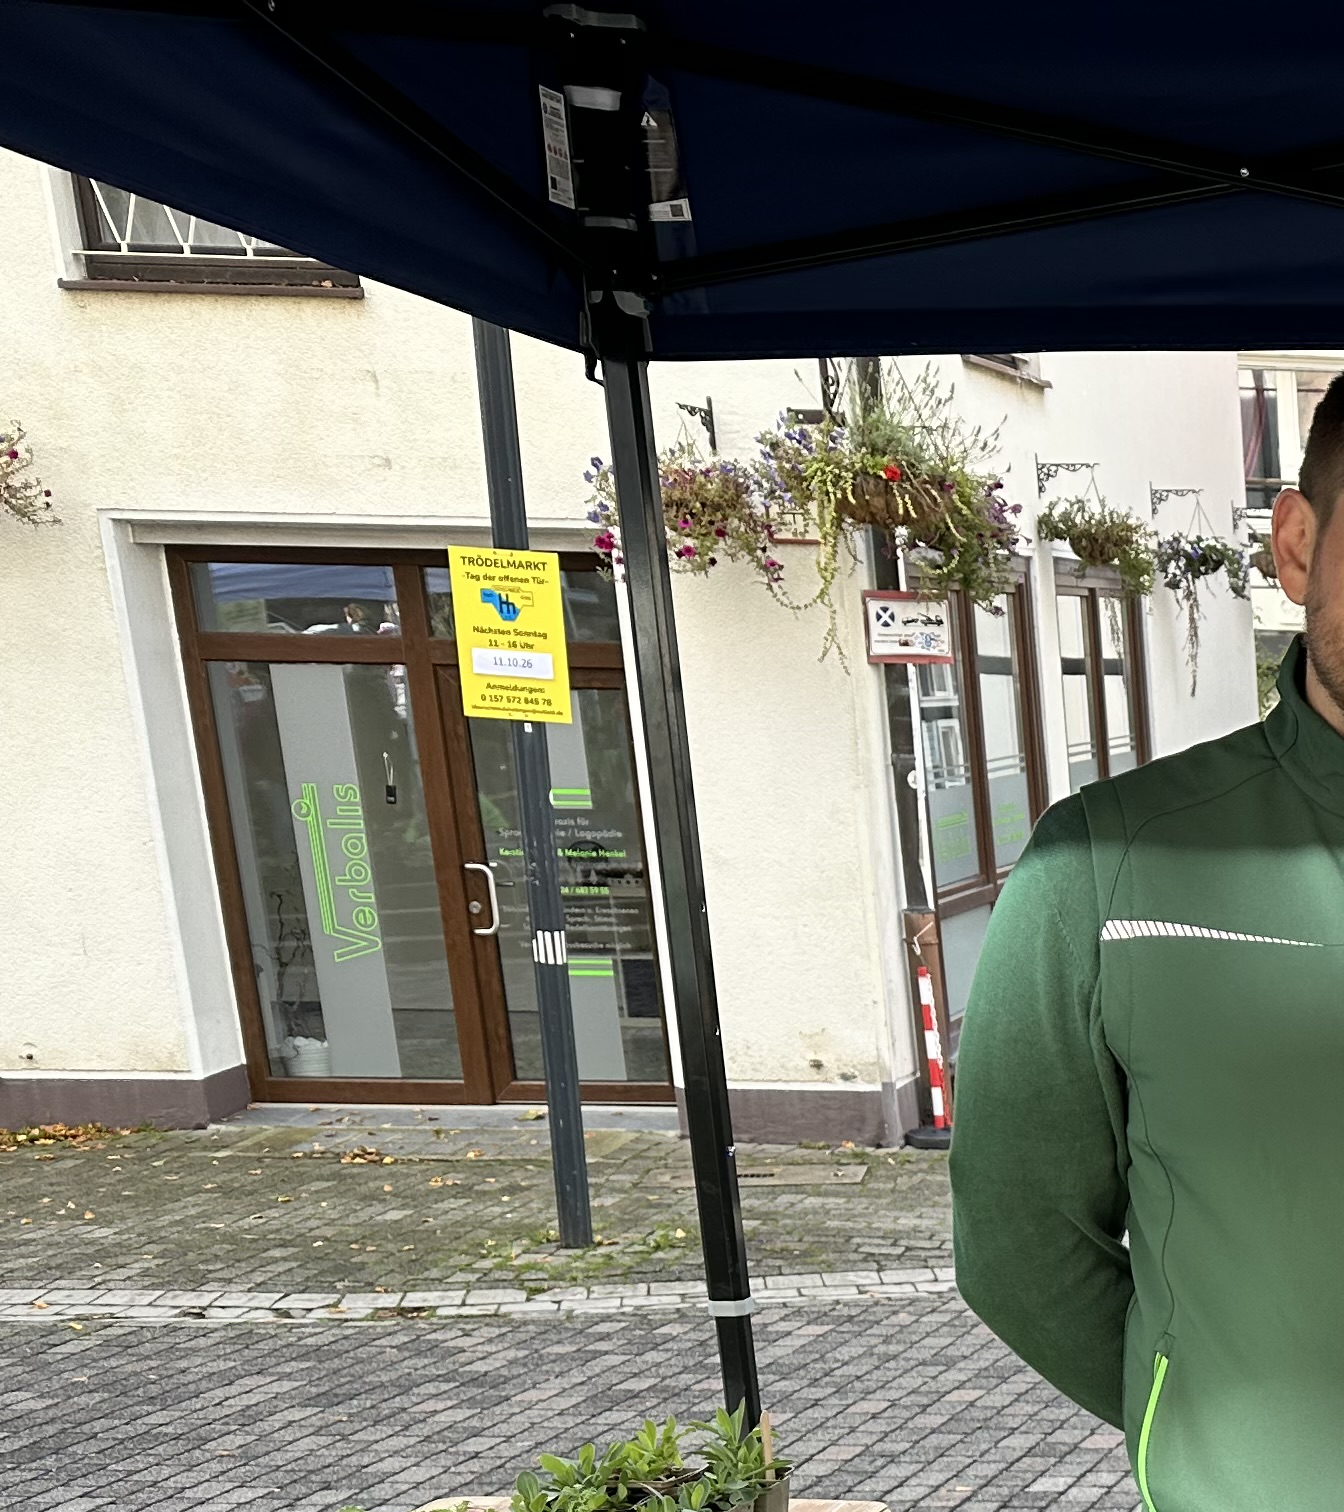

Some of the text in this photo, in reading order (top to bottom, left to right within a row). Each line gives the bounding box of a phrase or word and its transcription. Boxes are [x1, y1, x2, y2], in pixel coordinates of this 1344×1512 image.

[460, 554, 548, 572] TRÖDELMARKT
[482, 573, 497, 582] der
[498, 574, 530, 584] offenen
[513, 628, 548, 640] Sonntag
[519, 640, 535, 650] Uhr
[493, 656, 533, 669] 11.10.26
[554, 818, 575, 826] raxis
[327, 783, 382, 962] Verbalis
